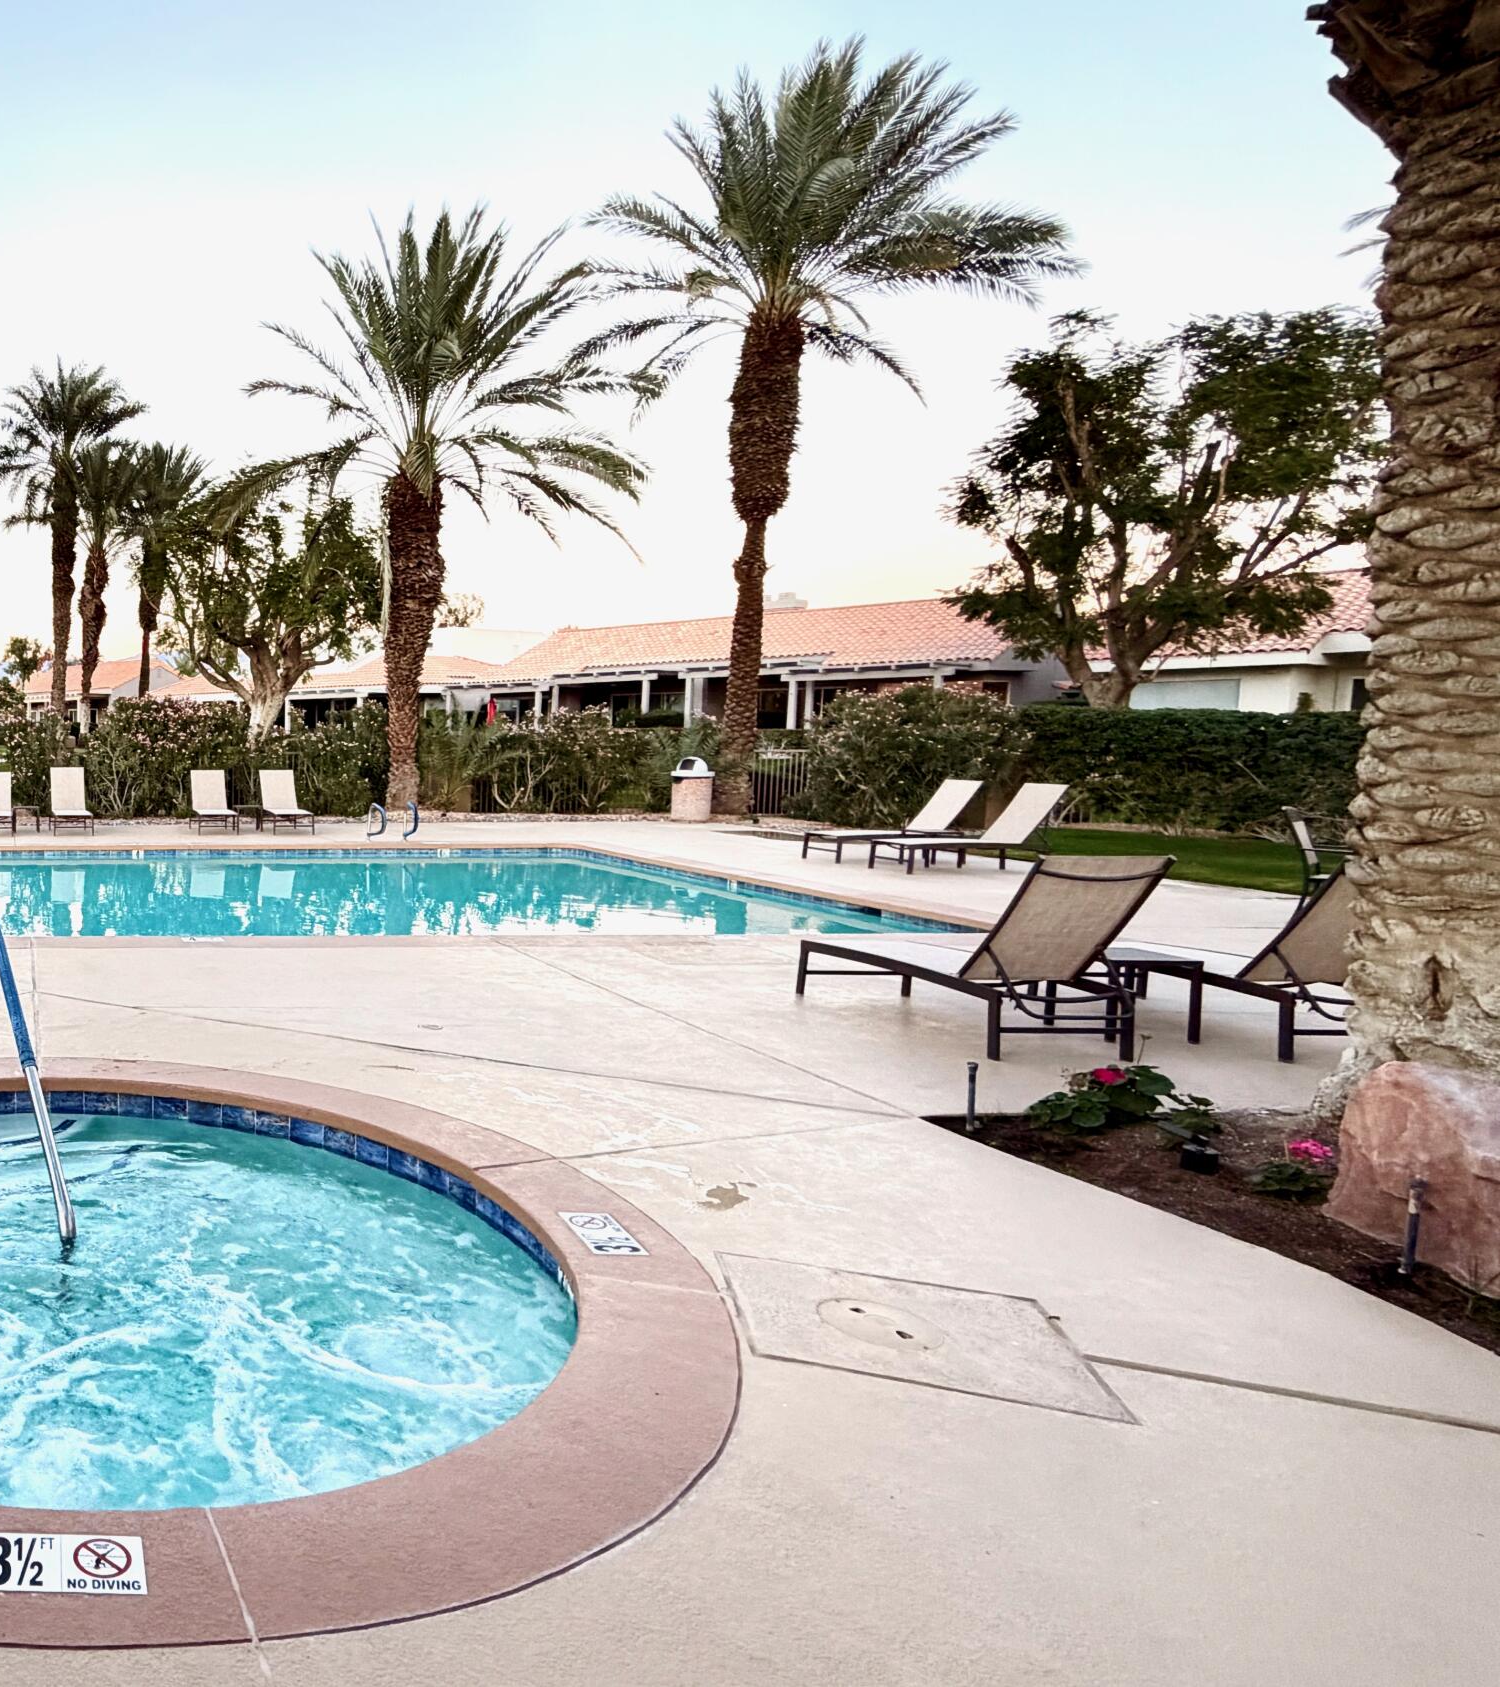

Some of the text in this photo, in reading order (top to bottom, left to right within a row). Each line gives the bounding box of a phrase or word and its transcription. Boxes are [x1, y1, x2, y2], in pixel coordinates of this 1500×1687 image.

[40, 1537, 55, 1550] FT
[67, 1578, 142, 1591] NO DIVING
